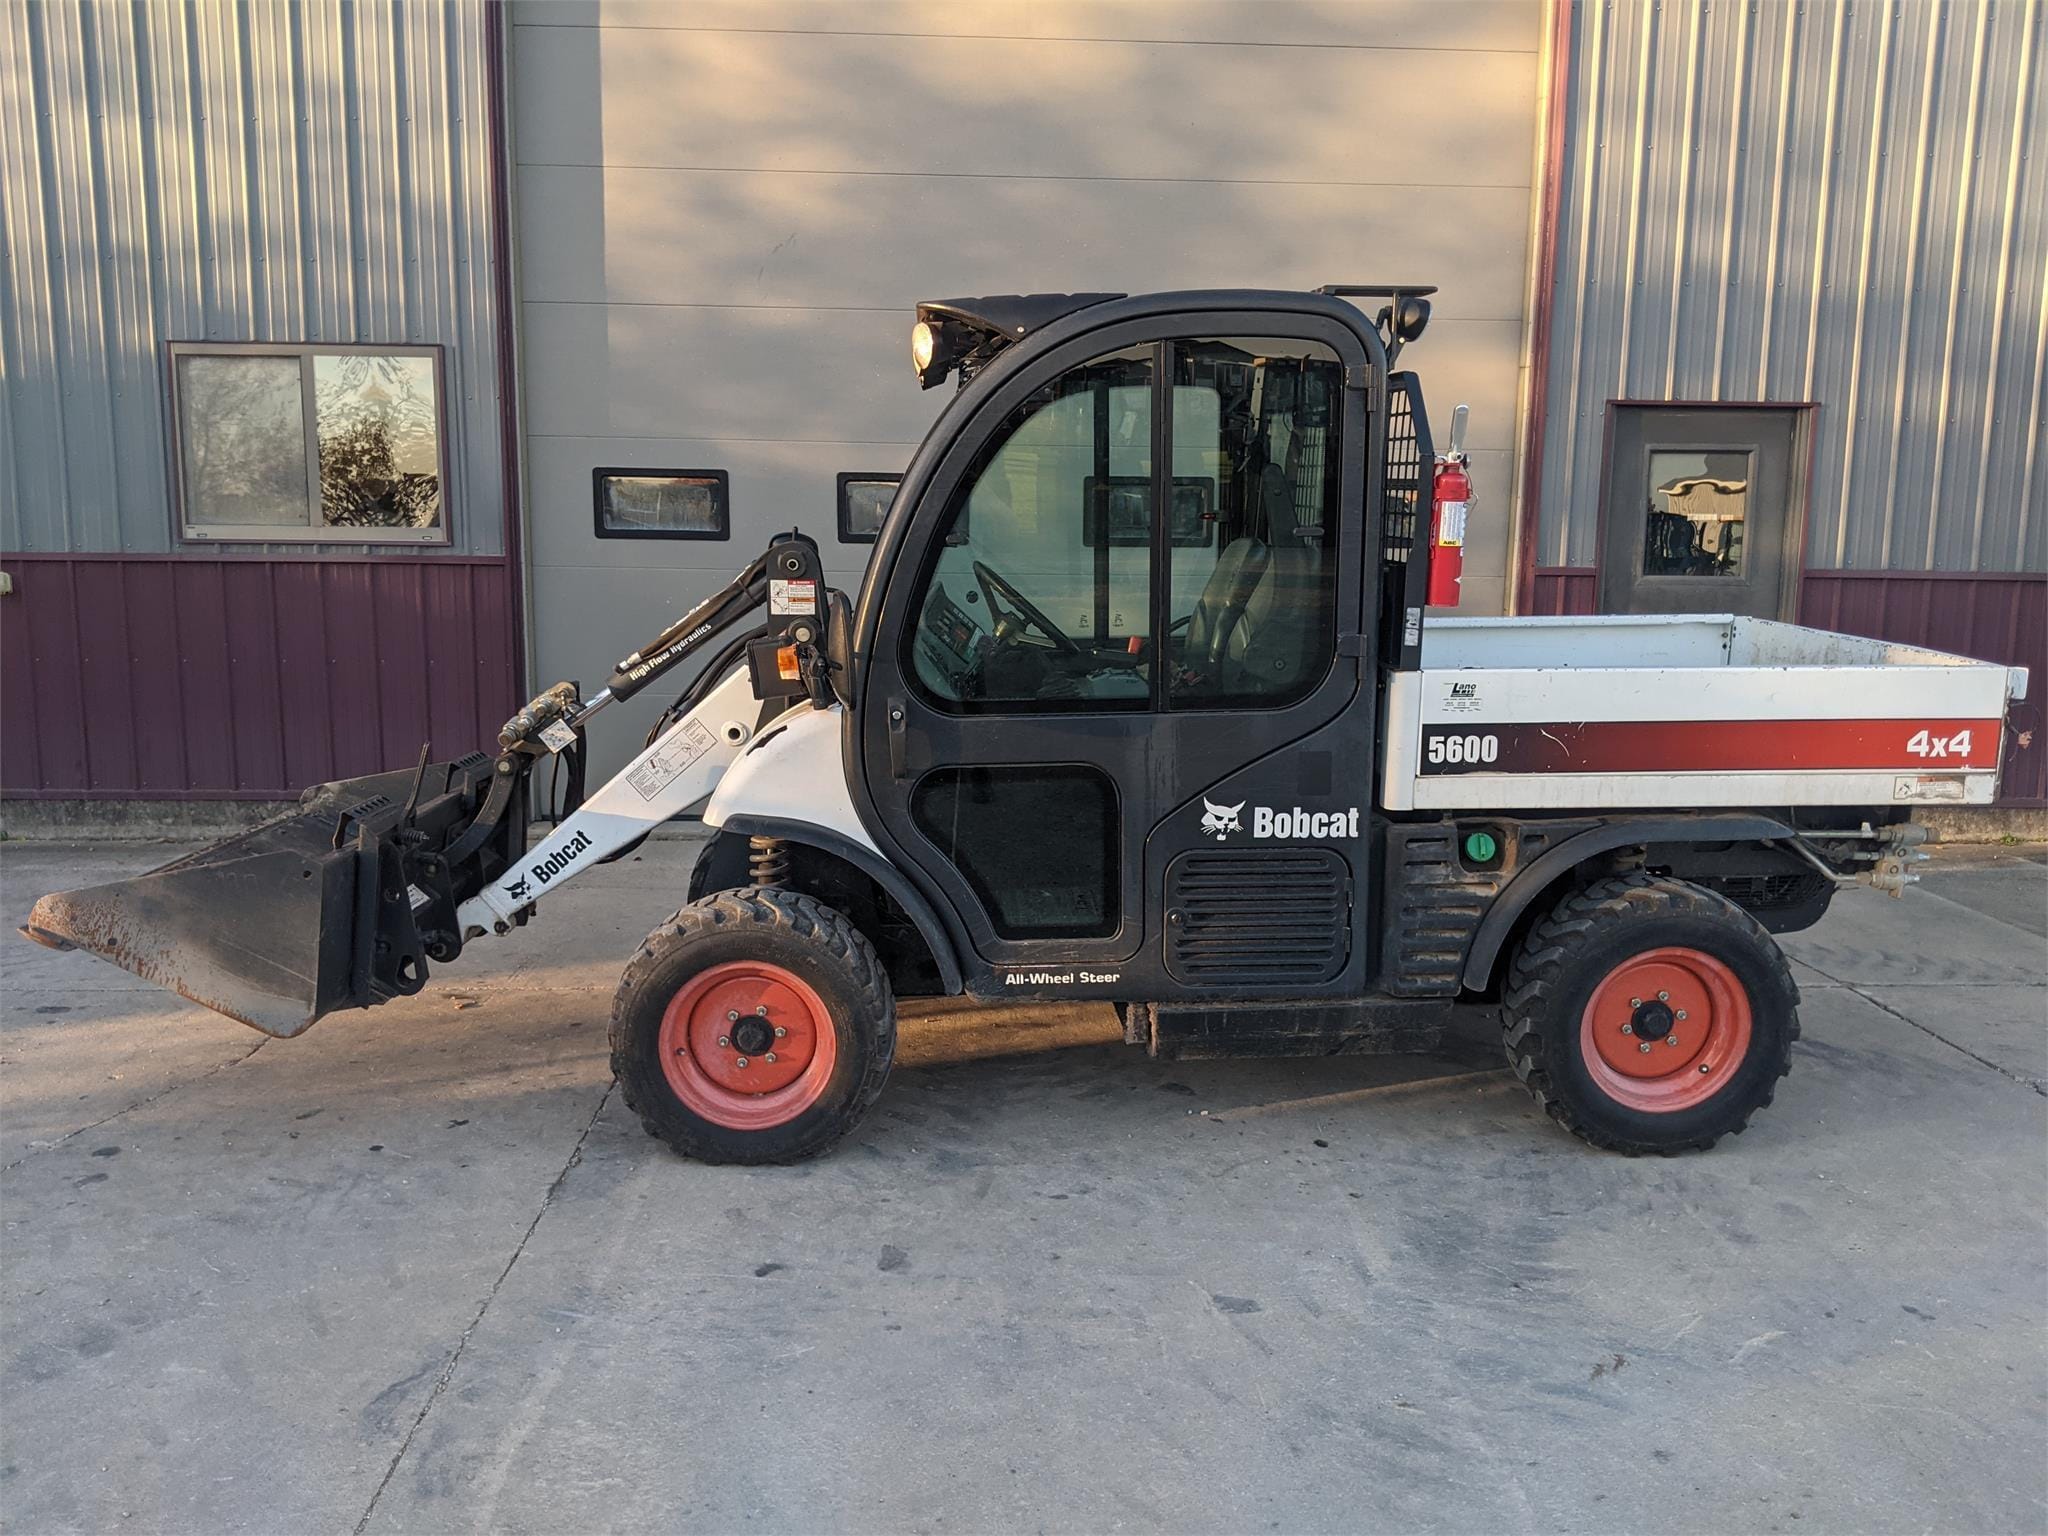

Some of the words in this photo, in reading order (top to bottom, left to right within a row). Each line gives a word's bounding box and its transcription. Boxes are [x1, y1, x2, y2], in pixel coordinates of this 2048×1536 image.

[629, 664, 651, 681] High
[648, 651, 671, 668] Flow
[669, 623, 712, 654] Hydraulics
[1452, 682, 1477, 694] Lano
[1428, 735, 1499, 764] 5600
[1906, 730, 1972, 758] 4x4
[1253, 806, 1360, 839] Bobcat
[531, 829, 593, 885] Bobcat
[1005, 972, 1074, 985] All-Wheel
[1079, 971, 1121, 984] Steer
